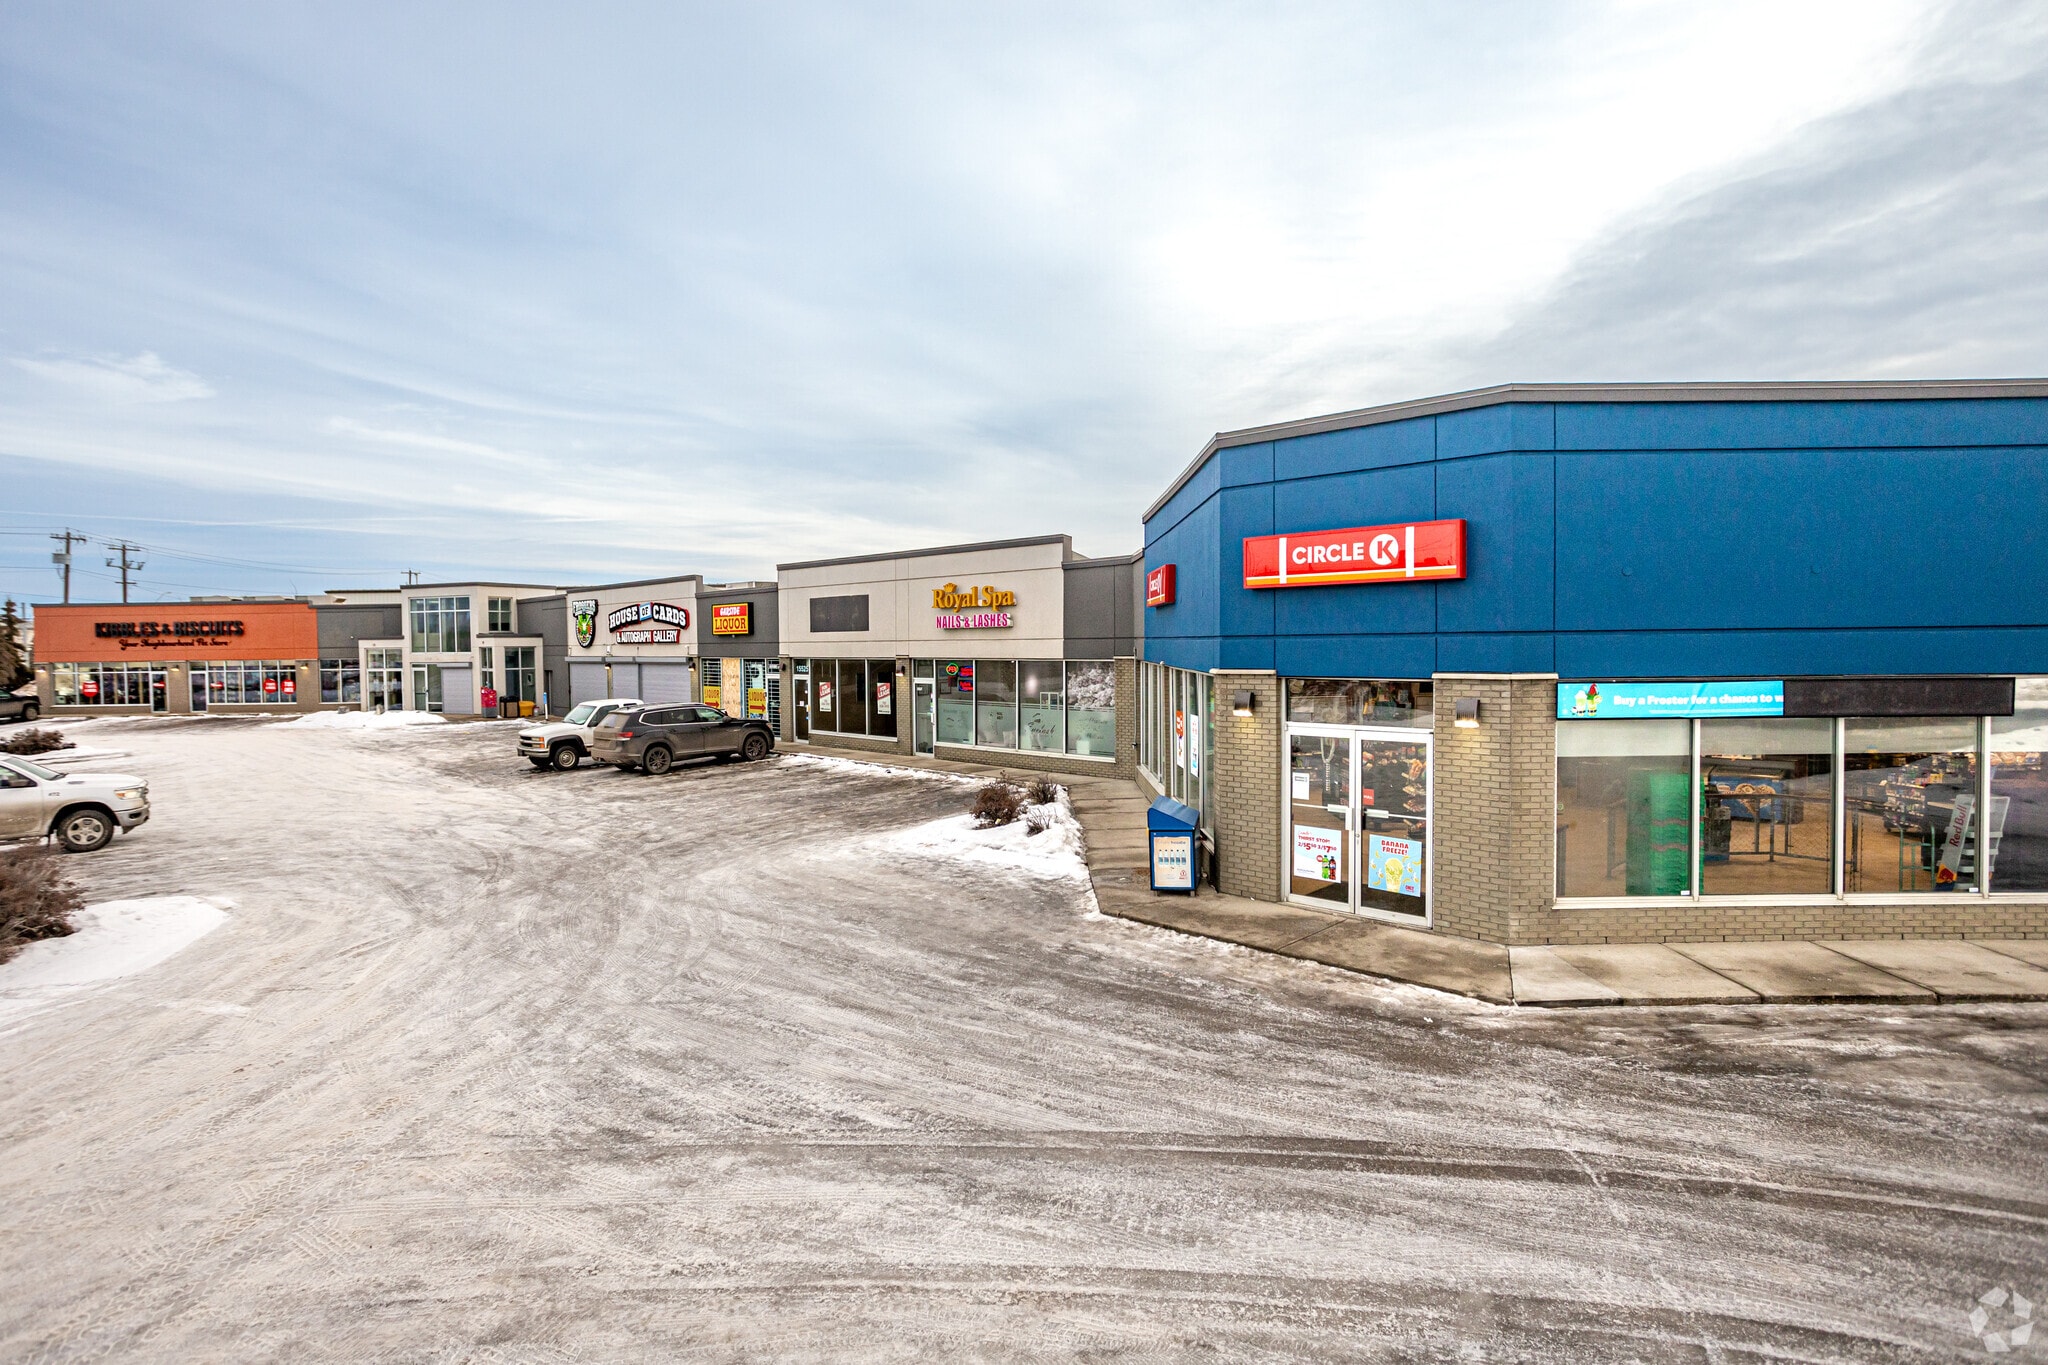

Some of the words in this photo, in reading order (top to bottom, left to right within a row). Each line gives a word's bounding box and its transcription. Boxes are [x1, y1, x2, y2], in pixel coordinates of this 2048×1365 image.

[1292, 542, 1365, 565] CIRCLE
[1373, 536, 1397, 563] K
[932, 586, 979, 613] Royal
[981, 585, 1015, 612] Spa
[609, 606, 638, 628] HOUSE
[641, 606, 649, 615] OF
[652, 605, 686, 626] CARDS
[714, 617, 747, 630] LIQUOR
[936, 615, 961, 628] NAILS
[964, 616, 970, 628] &
[973, 613, 1008, 627] LASHES
[95, 621, 159, 638] KIBBLES
[161, 623, 171, 635] &
[173, 620, 244, 636] BISCUITS
[616, 635, 621, 643] &
[621, 630, 651, 643] AUTOGRAPH
[652, 629, 678, 643] GALLERY
[118, 638, 138, 650] Your
[196, 637, 208, 646] Pet
[209, 637, 229, 646] Store
[1613, 695, 1637, 708] Buy
[1637, 697, 1646, 705] a
[1647, 695, 1689, 706] Froster
[1690, 694, 1709, 705] for
[1719, 693, 1758, 705] chance
[1759, 694, 1773, 704] to
[1955, 804, 1967, 826] Bull
[1949, 825, 1962, 847] Red
[1381, 840, 1409, 849] BANANA
[1382, 846, 1408, 855] FREEZE!
